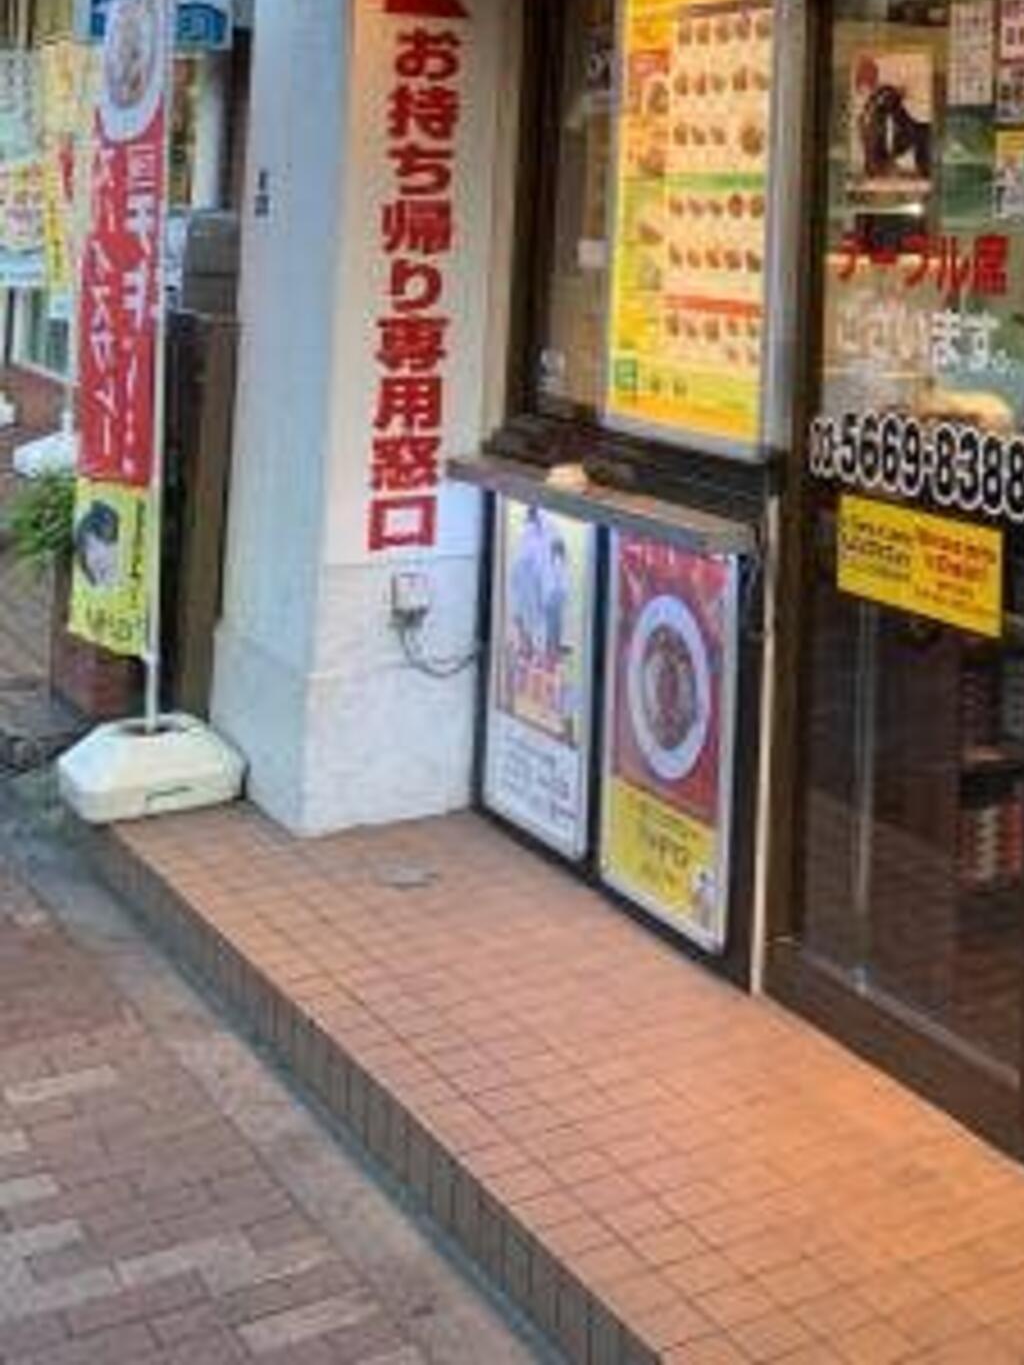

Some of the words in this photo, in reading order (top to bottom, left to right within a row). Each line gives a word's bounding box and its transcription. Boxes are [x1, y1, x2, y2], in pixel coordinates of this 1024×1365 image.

[368, 28, 461, 553] お持ち帰り専用窓口
